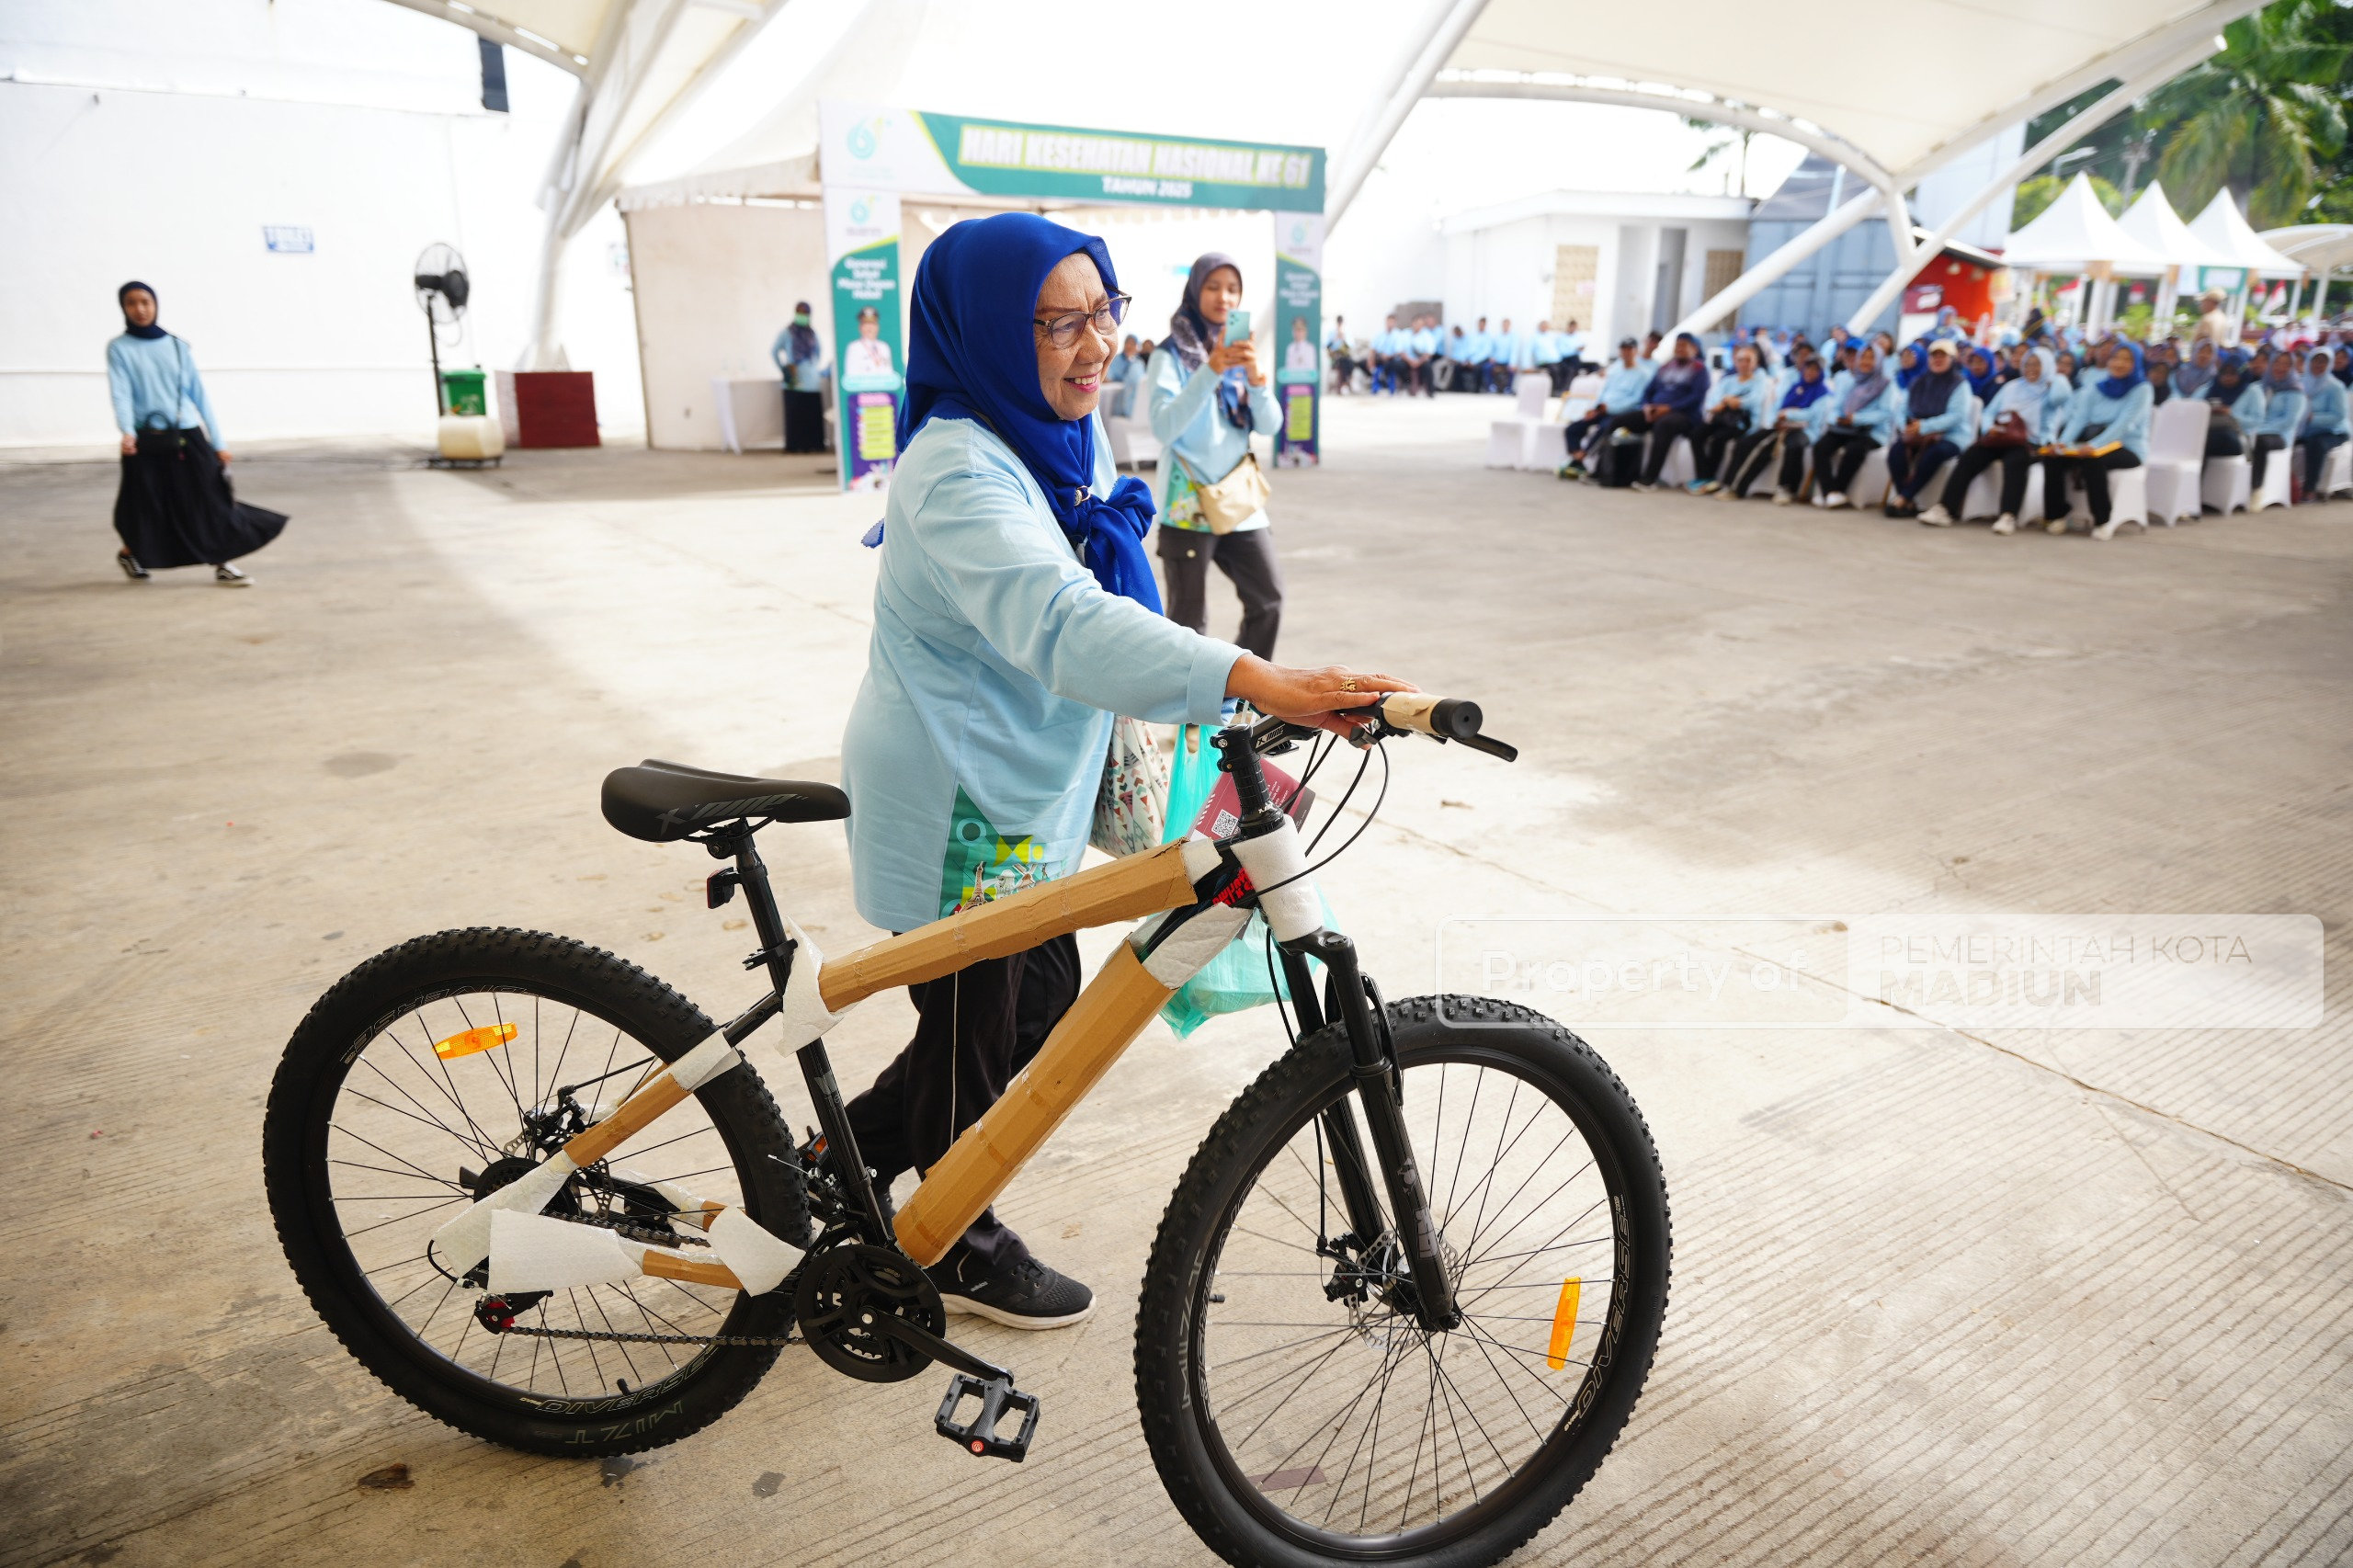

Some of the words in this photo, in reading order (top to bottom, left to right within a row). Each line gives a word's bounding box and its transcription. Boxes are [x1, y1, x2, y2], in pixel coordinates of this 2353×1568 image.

[960, 125, 1023, 167] HARI
[1024, 131, 1152, 176] KESEHATAN
[1154, 143, 1254, 183] NASIONAL
[1102, 176, 1157, 196] TAHUN
[1578, 1211, 1631, 1418] DIVERSE
[535, 1351, 709, 1415] DIVERSE
